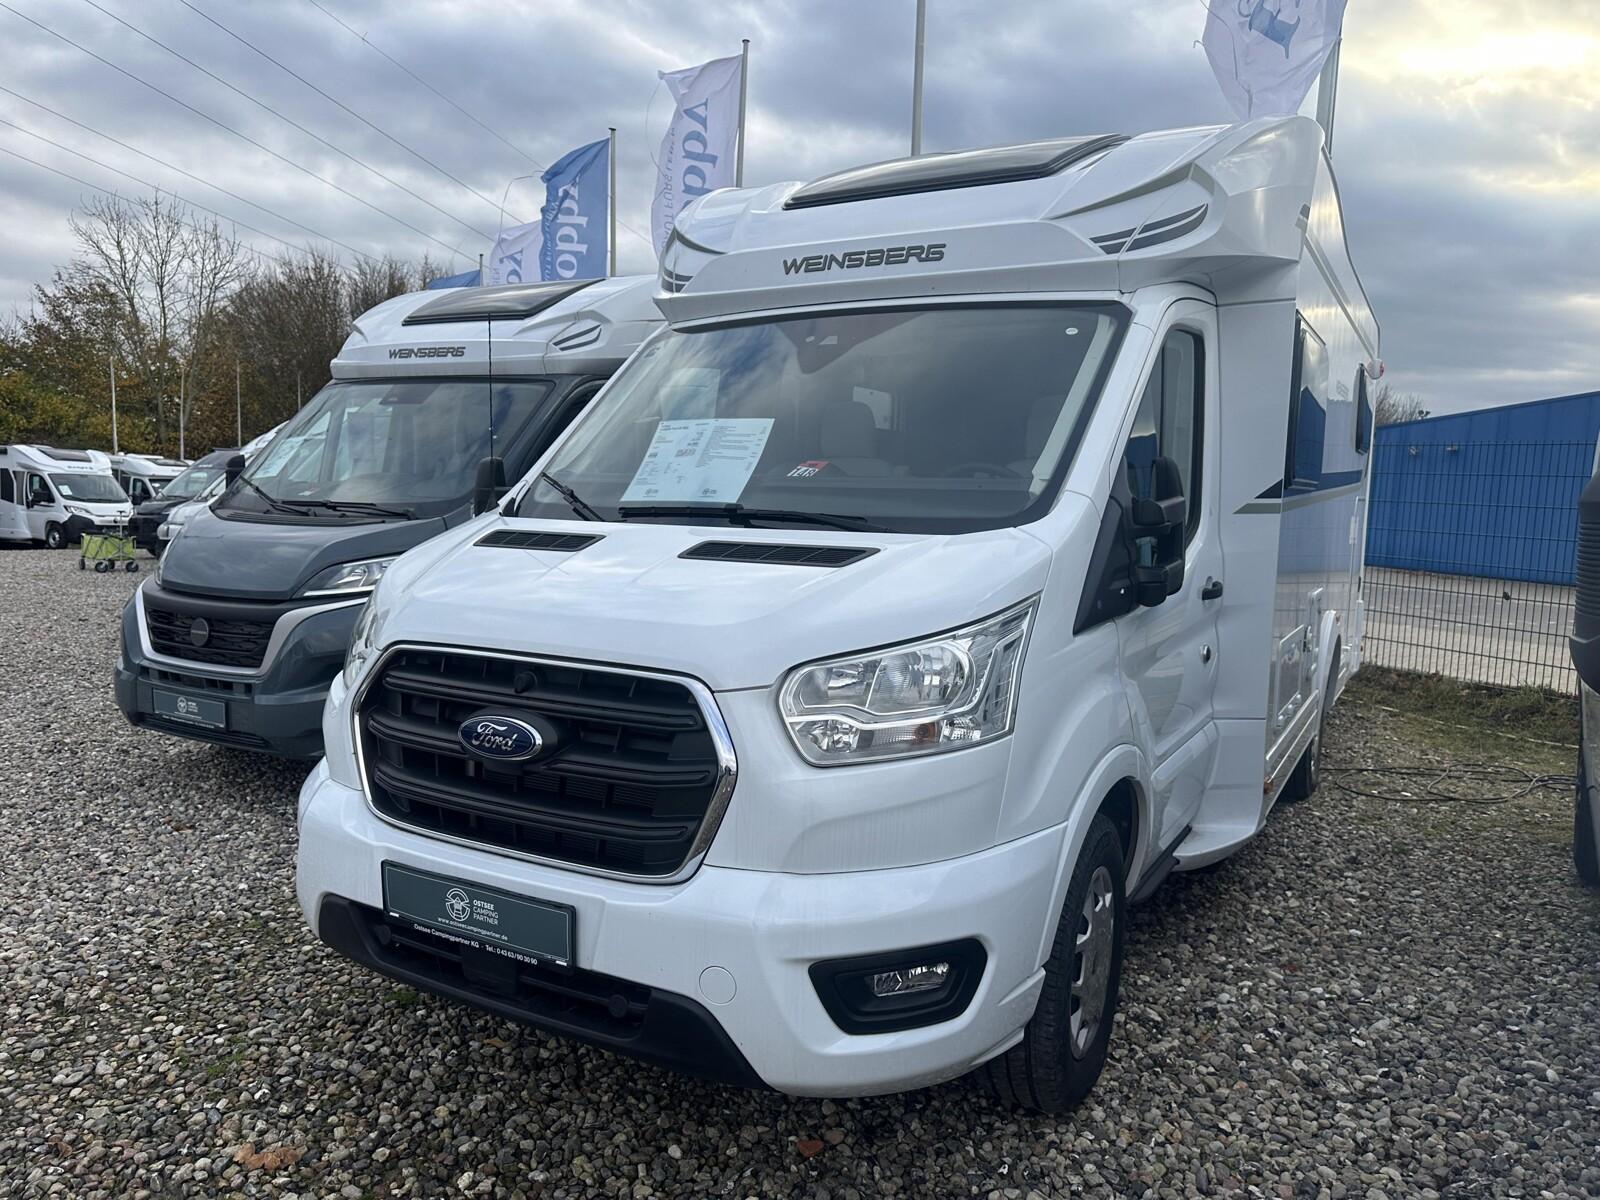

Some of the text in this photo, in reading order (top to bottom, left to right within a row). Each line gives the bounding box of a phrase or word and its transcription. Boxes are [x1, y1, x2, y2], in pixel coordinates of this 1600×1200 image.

[782, 243, 947, 276] WEINSBERG
[388, 346, 466, 360] WEINSBERG
[471, 721, 518, 751] Ford
[473, 899, 495, 911] OSTSEE
[473, 906, 498, 919] CAMPING
[473, 912, 498, 926] PARTNER
